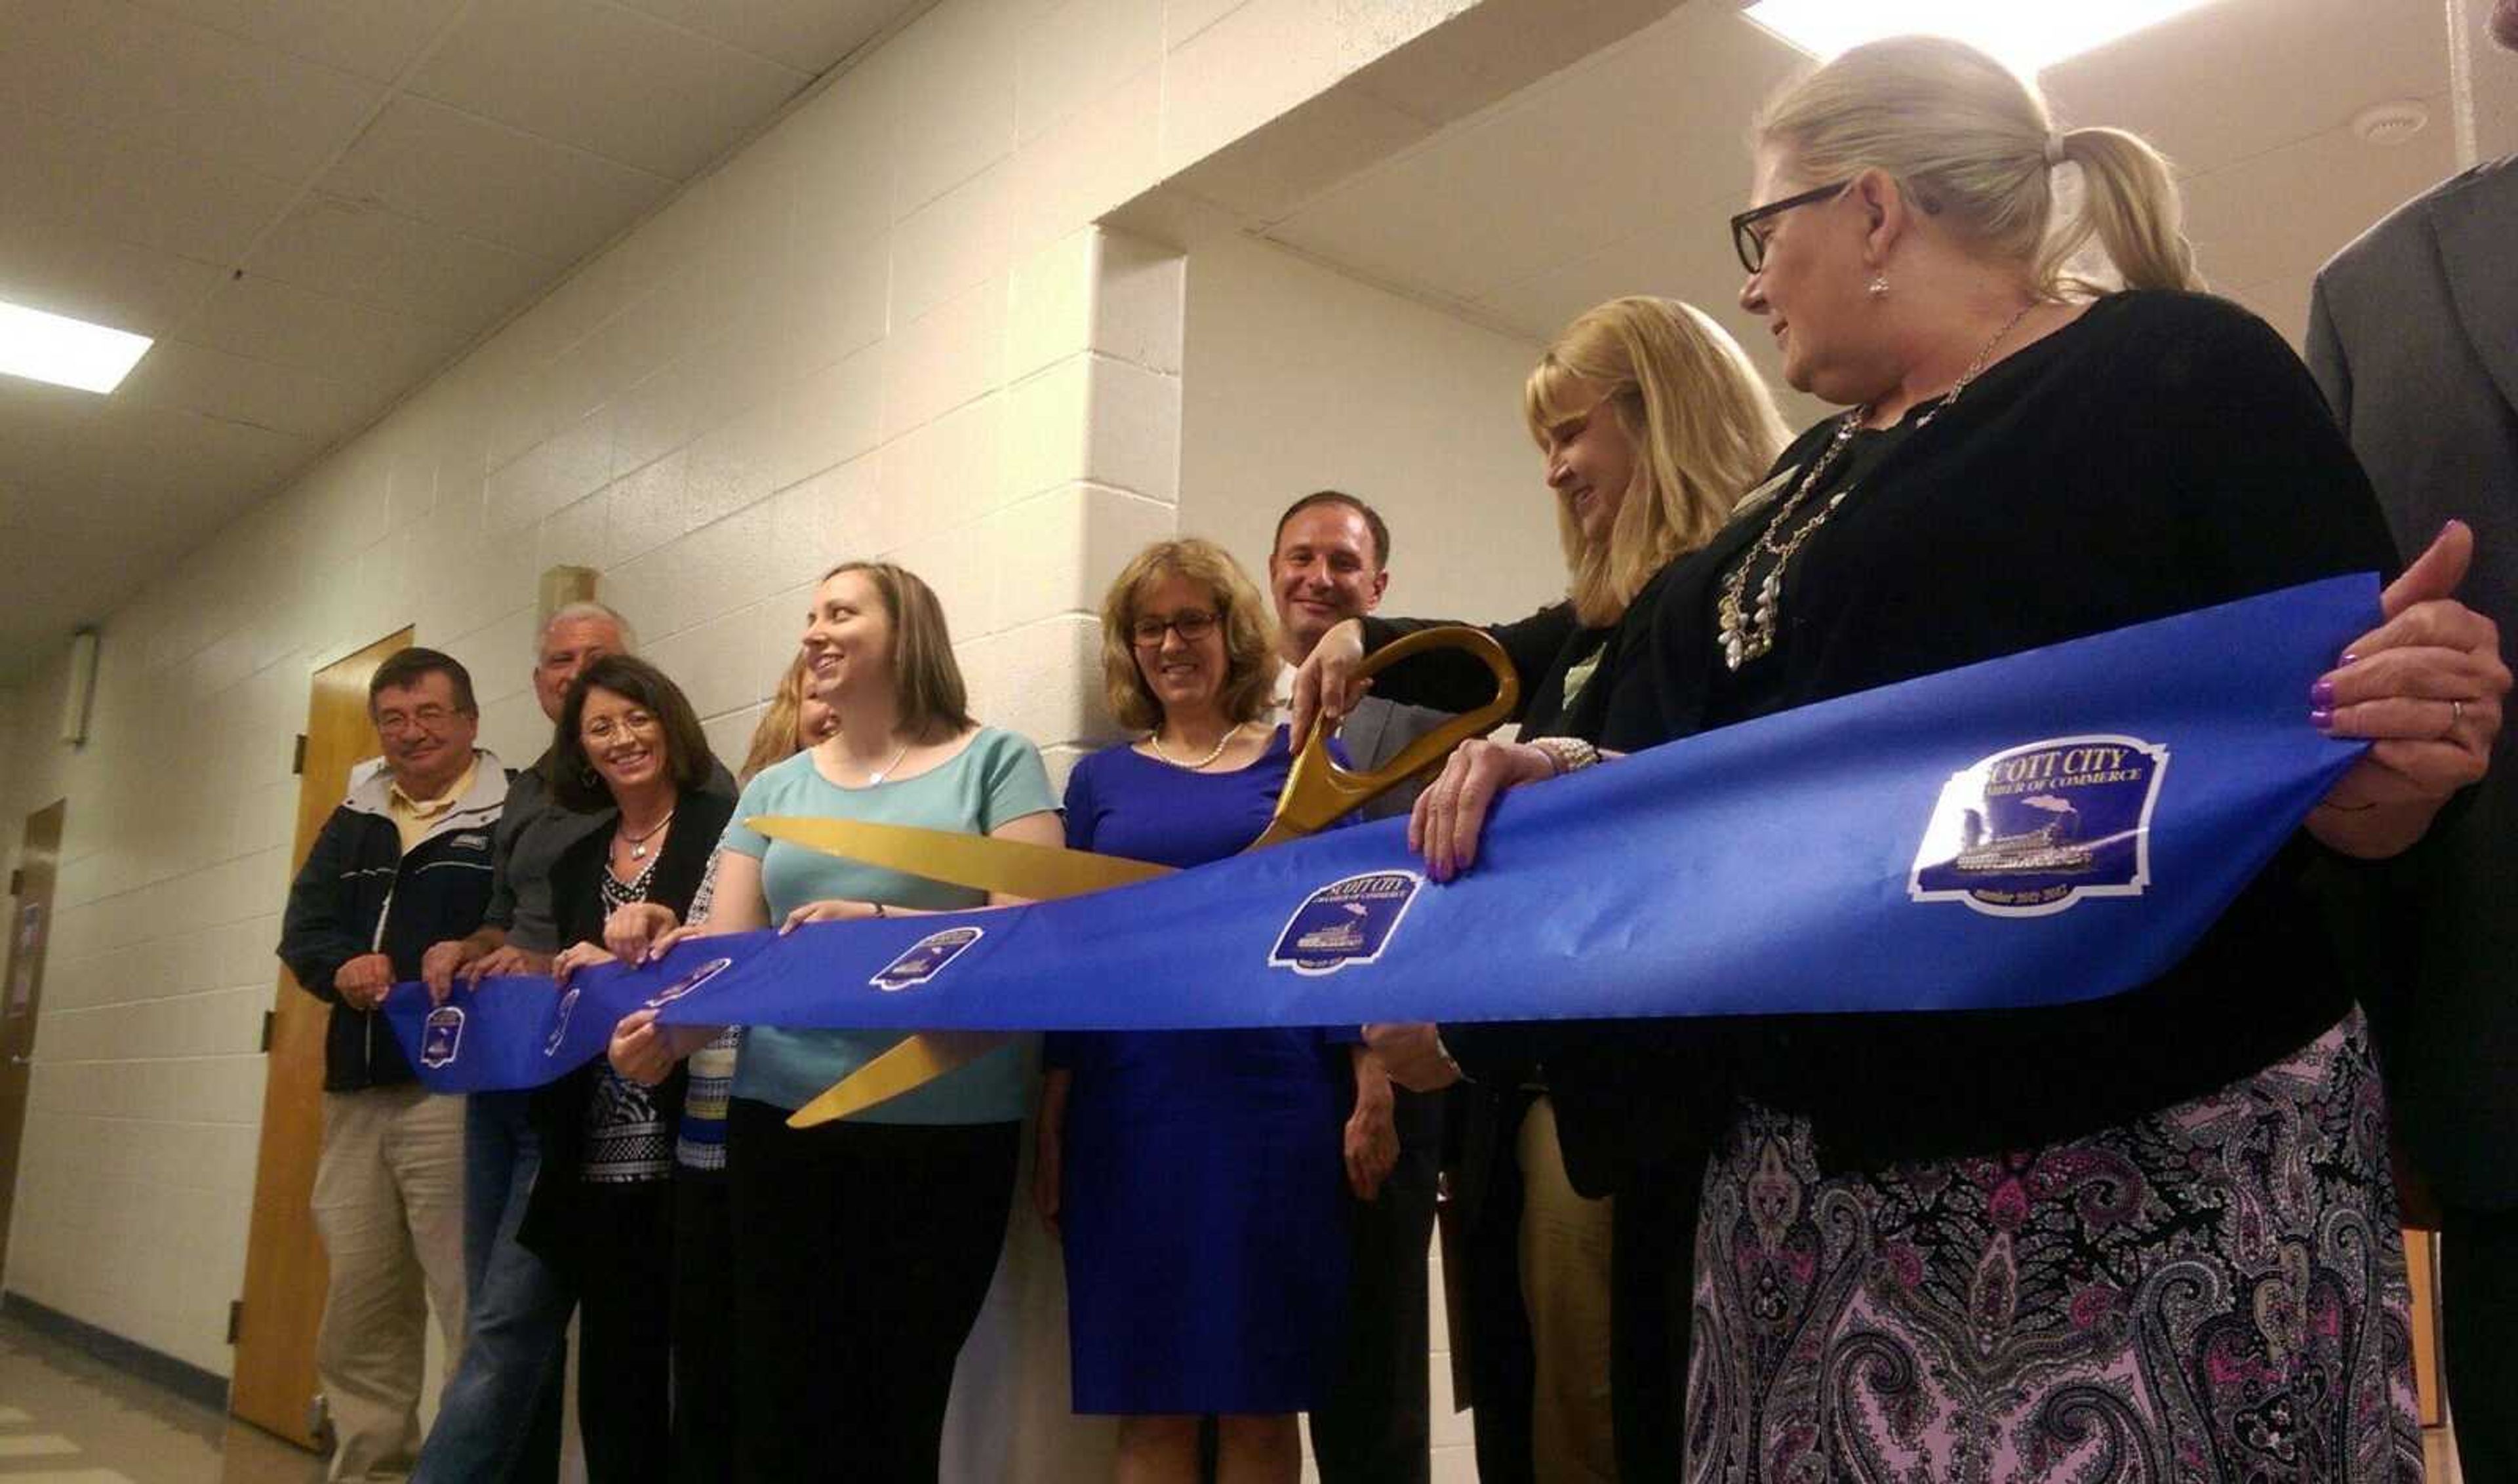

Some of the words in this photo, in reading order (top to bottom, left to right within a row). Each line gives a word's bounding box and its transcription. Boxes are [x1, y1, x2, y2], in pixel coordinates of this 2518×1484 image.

[1987, 752, 2061, 782] COTT
[2063, 748, 2130, 774] CITY
[2050, 767, 2142, 788] COMMERCE
